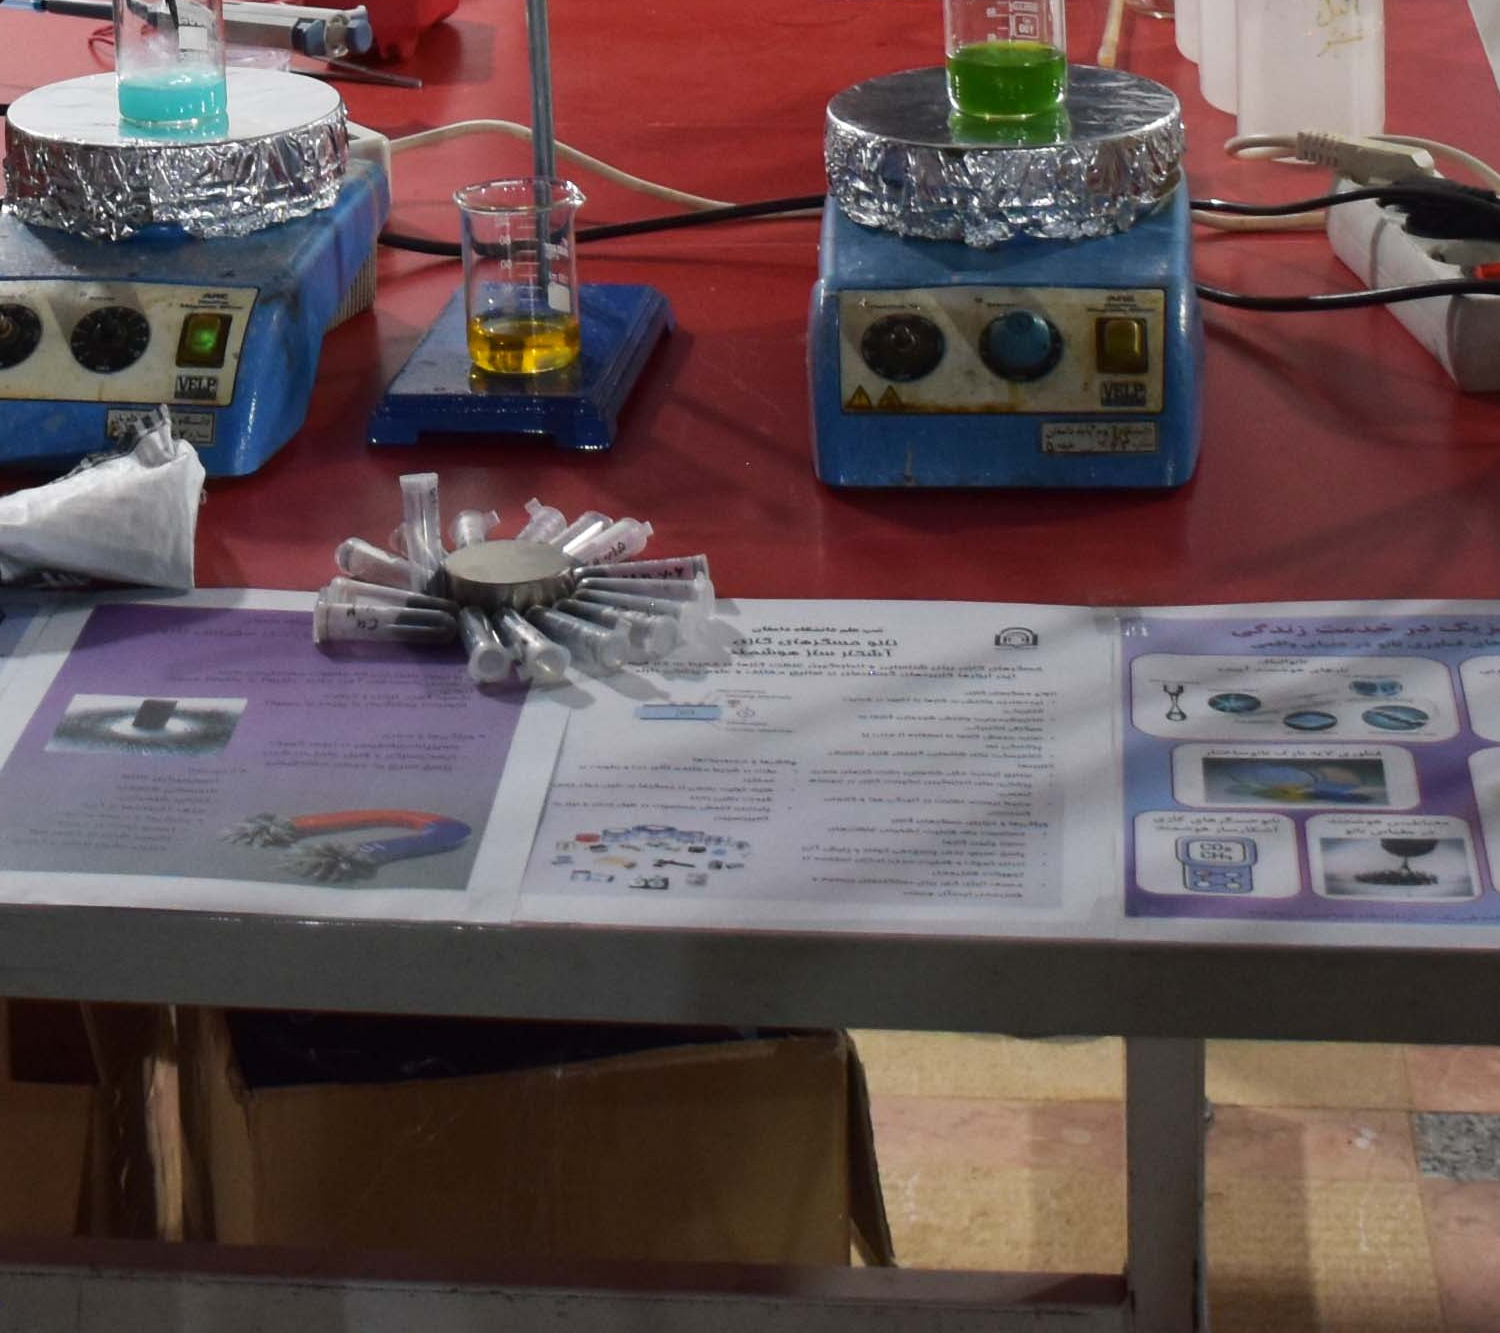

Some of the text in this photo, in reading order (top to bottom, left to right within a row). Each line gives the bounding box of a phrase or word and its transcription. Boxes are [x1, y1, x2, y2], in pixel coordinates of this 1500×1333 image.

[1231, 622, 1308, 638] زندگی
[1315, 621, 1393, 634] خدمت
[1404, 624, 1431, 637] در
